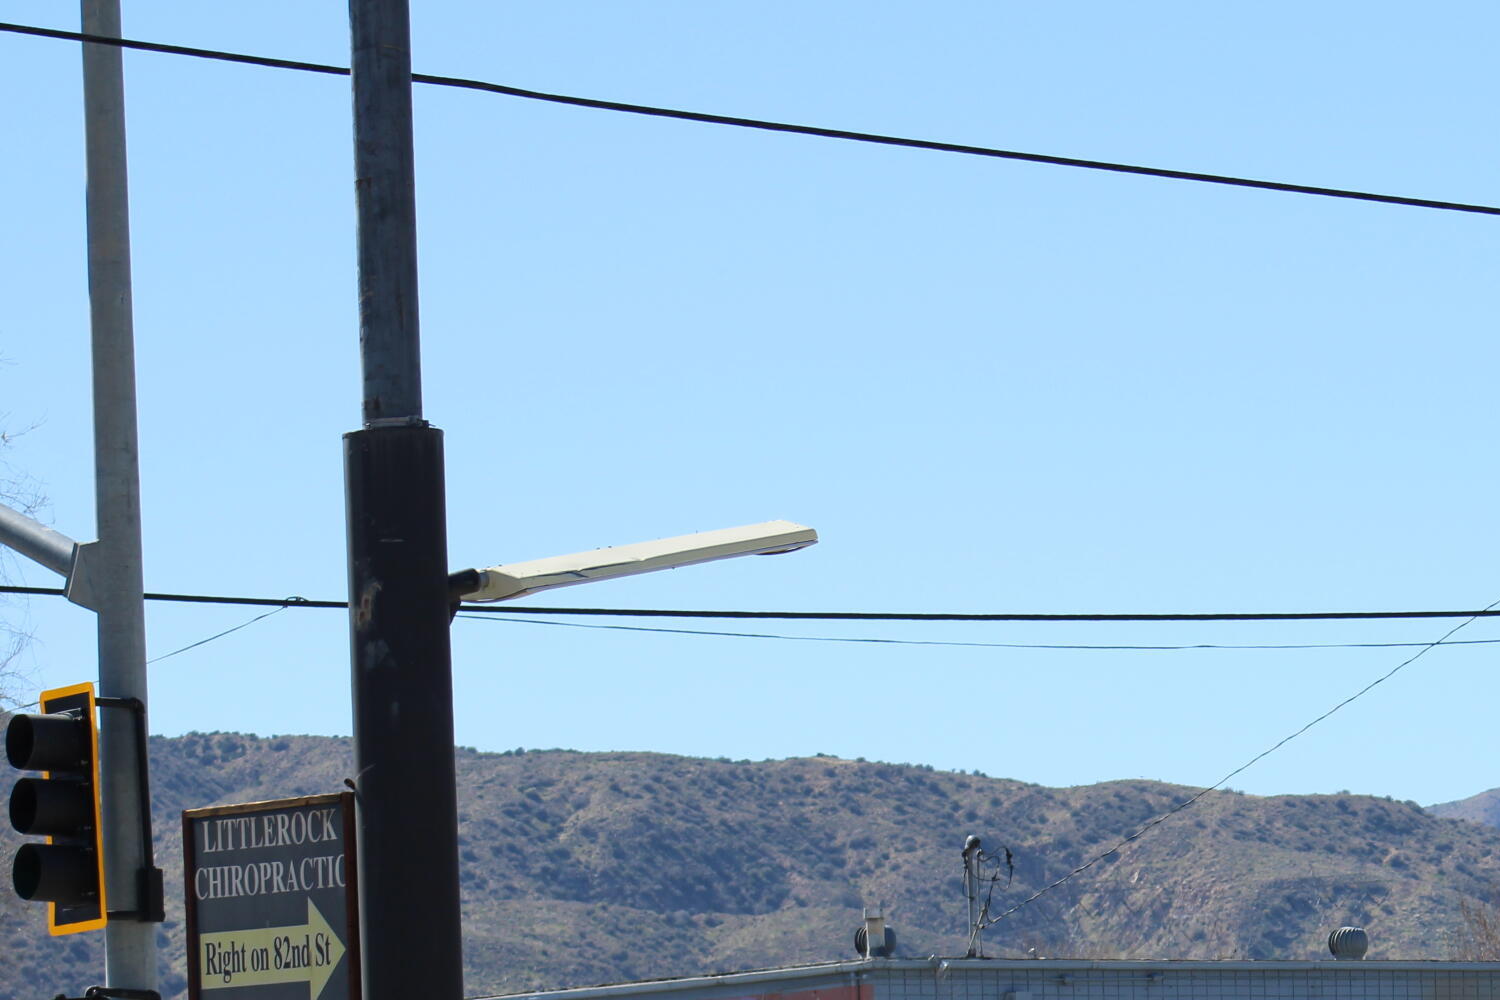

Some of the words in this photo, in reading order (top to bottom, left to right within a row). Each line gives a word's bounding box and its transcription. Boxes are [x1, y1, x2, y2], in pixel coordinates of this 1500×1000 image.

[202, 808, 338, 853] LITTLEROCK
[194, 854, 346, 900] CHIROPRACTIC
[205, 942, 247, 984] Right
[251, 946, 270, 972] on
[273, 934, 311, 969] 82nd
[315, 932, 331, 967] St
